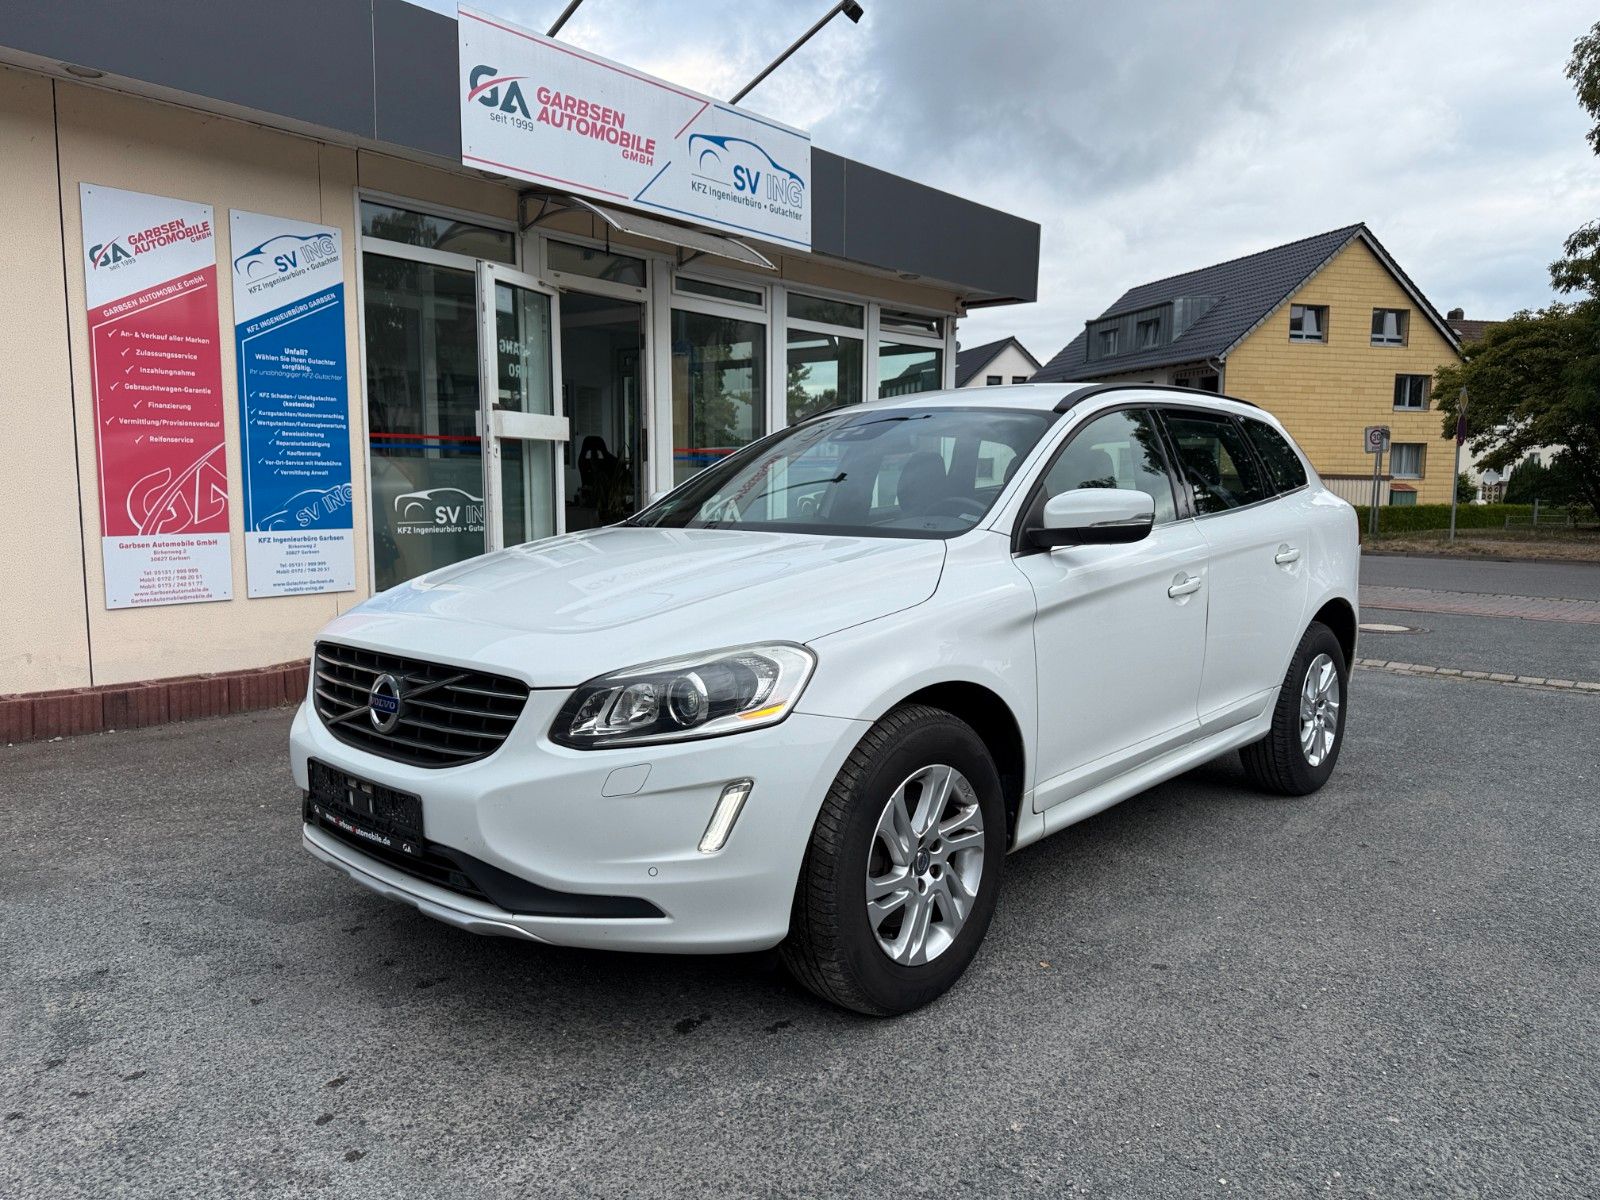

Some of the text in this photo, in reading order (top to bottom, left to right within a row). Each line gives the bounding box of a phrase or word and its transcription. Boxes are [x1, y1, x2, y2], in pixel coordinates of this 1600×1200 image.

[536, 86, 626, 129] GARBSEN
[489, 111, 534, 132] seit 1999
[536, 106, 656, 156] AUTOMOBILE
[621, 149, 654, 167] GMBH
[733, 165, 802, 209] SV ING
[691, 180, 802, 221] KFZ Ingenieurbüro Gutachter
[127, 218, 186, 246] GARBSEN
[134, 221, 211, 256] AUTOMOBILE
[190, 231, 213, 244] GMBH
[274, 236, 337, 273] SV ING
[247, 255, 339, 295] KFZ Ingenieurbüro Gutachter
[103, 274, 205, 317] GARBSEN AUTOMOBILE GmbH
[246, 293, 336, 334] KFZ INGENIEURBÜRO GARBSEN
[120, 330, 133, 338] An-
[141, 332, 168, 341] Verkauf
[185, 336, 210, 345] Marken
[135, 348, 199, 361] Zulassungsservice
[255, 353, 279, 361] Wählen
[307, 357, 336, 366] Gutachter
[284, 347, 309, 356] Unfall?
[139, 366, 196, 377] Inzahlungnahme
[124, 383, 212, 395] Gebrauchtwagen-Garantie
[147, 401, 192, 411] Finanzierung
[119, 417, 220, 428] Vermittlung/Provisionsverkauf
[149, 435, 195, 444] Reifenservice
[295, 501, 321, 528] SV
[435, 505, 484, 524] SV IN
[413, 526, 462, 535] Ingenieurbüro
[119, 542, 151, 550] Garbsen
[152, 540, 195, 548] Automobile
[272, 536, 319, 544] Ingenieurbüro
